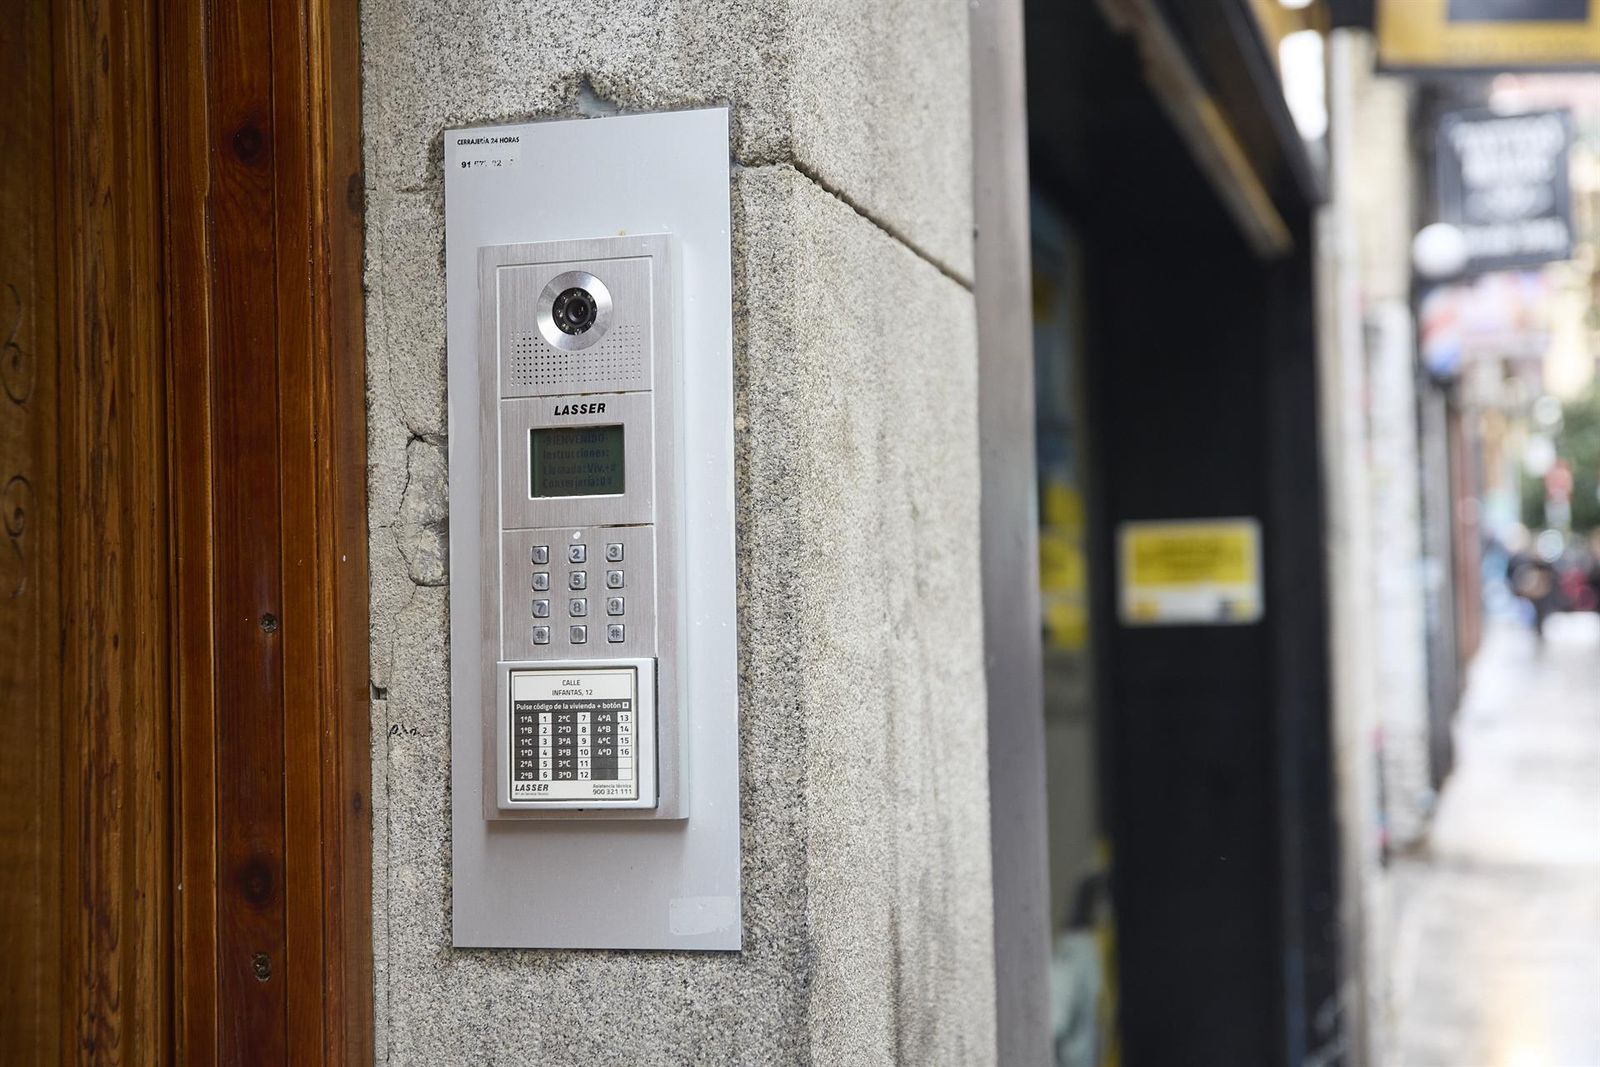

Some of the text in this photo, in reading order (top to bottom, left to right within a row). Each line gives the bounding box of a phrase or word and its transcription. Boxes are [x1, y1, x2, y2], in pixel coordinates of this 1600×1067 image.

[500, 136, 520, 144] HORAS
[554, 403, 606, 415] LASSER
[536, 547, 618, 560] 1 2 3
[573, 575, 580, 585] 5
[610, 574, 619, 585] 6
[536, 601, 619, 613] 7 8 9
[533, 703, 553, 711] código
